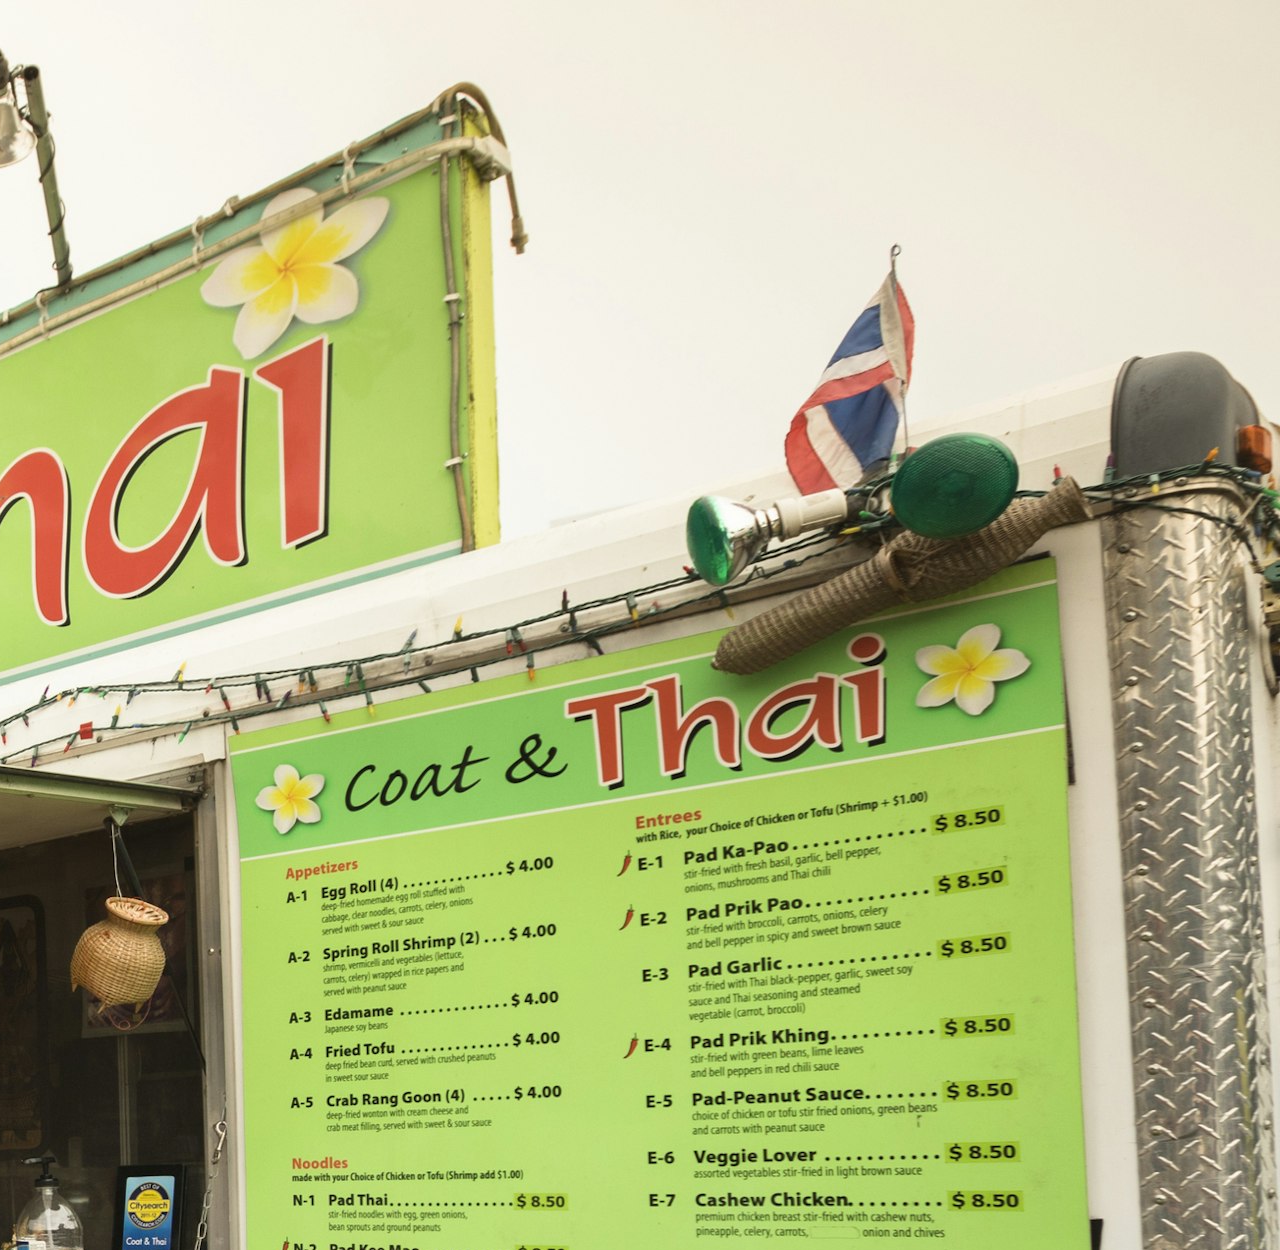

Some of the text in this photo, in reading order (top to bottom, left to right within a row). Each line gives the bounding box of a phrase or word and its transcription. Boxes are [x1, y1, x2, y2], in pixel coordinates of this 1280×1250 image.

[344, 632, 889, 812] Coat & Thai
[636, 810, 702, 830] Entrees
[638, 856, 663, 871] E-1
[684, 847, 718, 865] Pad
[722, 841, 789, 859] Ka-Pao
[286, 861, 359, 881] Appetizers
[684, 866, 831, 894] onions, mushrooms and Thai chili
[286, 890, 307, 904] A-1
[322, 887, 346, 901] Egg
[350, 880, 376, 895] Roll
[380, 877, 398, 892] (4)
[322, 925, 343, 936] served
[344, 924, 360, 933] with
[361, 922, 381, 931] sweet
[388, 920, 404, 928] sour
[405, 917, 424, 926] sauce
[288, 950, 310, 964] A-2
[323, 945, 368, 962] Spring
[372, 940, 399, 954] Roll
[403, 936, 456, 951] Shrimp
[460, 931, 480, 946] (2)
[642, 968, 669, 982] E-3
[688, 961, 722, 978] Pad
[727, 957, 782, 974] Garlic
[324, 1022, 389, 1035] Japanese soy beans
[291, 1096, 314, 1109] A-5
[326, 1094, 358, 1107] Crab
[362, 1094, 398, 1108] Rang
[402, 1092, 441, 1104] Goon
[446, 1089, 465, 1104] (4)
[646, 1094, 673, 1108] E-5
[692, 1090, 801, 1106] Pad-Peanut
[806, 1088, 864, 1102] Sauce
[292, 1156, 348, 1170] Noodles
[130, 1202, 168, 1210] Citysearch
[293, 1194, 314, 1206] N-1
[329, 1194, 354, 1206] Pad
[357, 1194, 388, 1206] Thai
[649, 1194, 676, 1207] E-7
[695, 1192, 766, 1207] Cashew
[770, 1192, 849, 1207] Chicken
[126, 1237, 167, 1246] Coat & Thai
